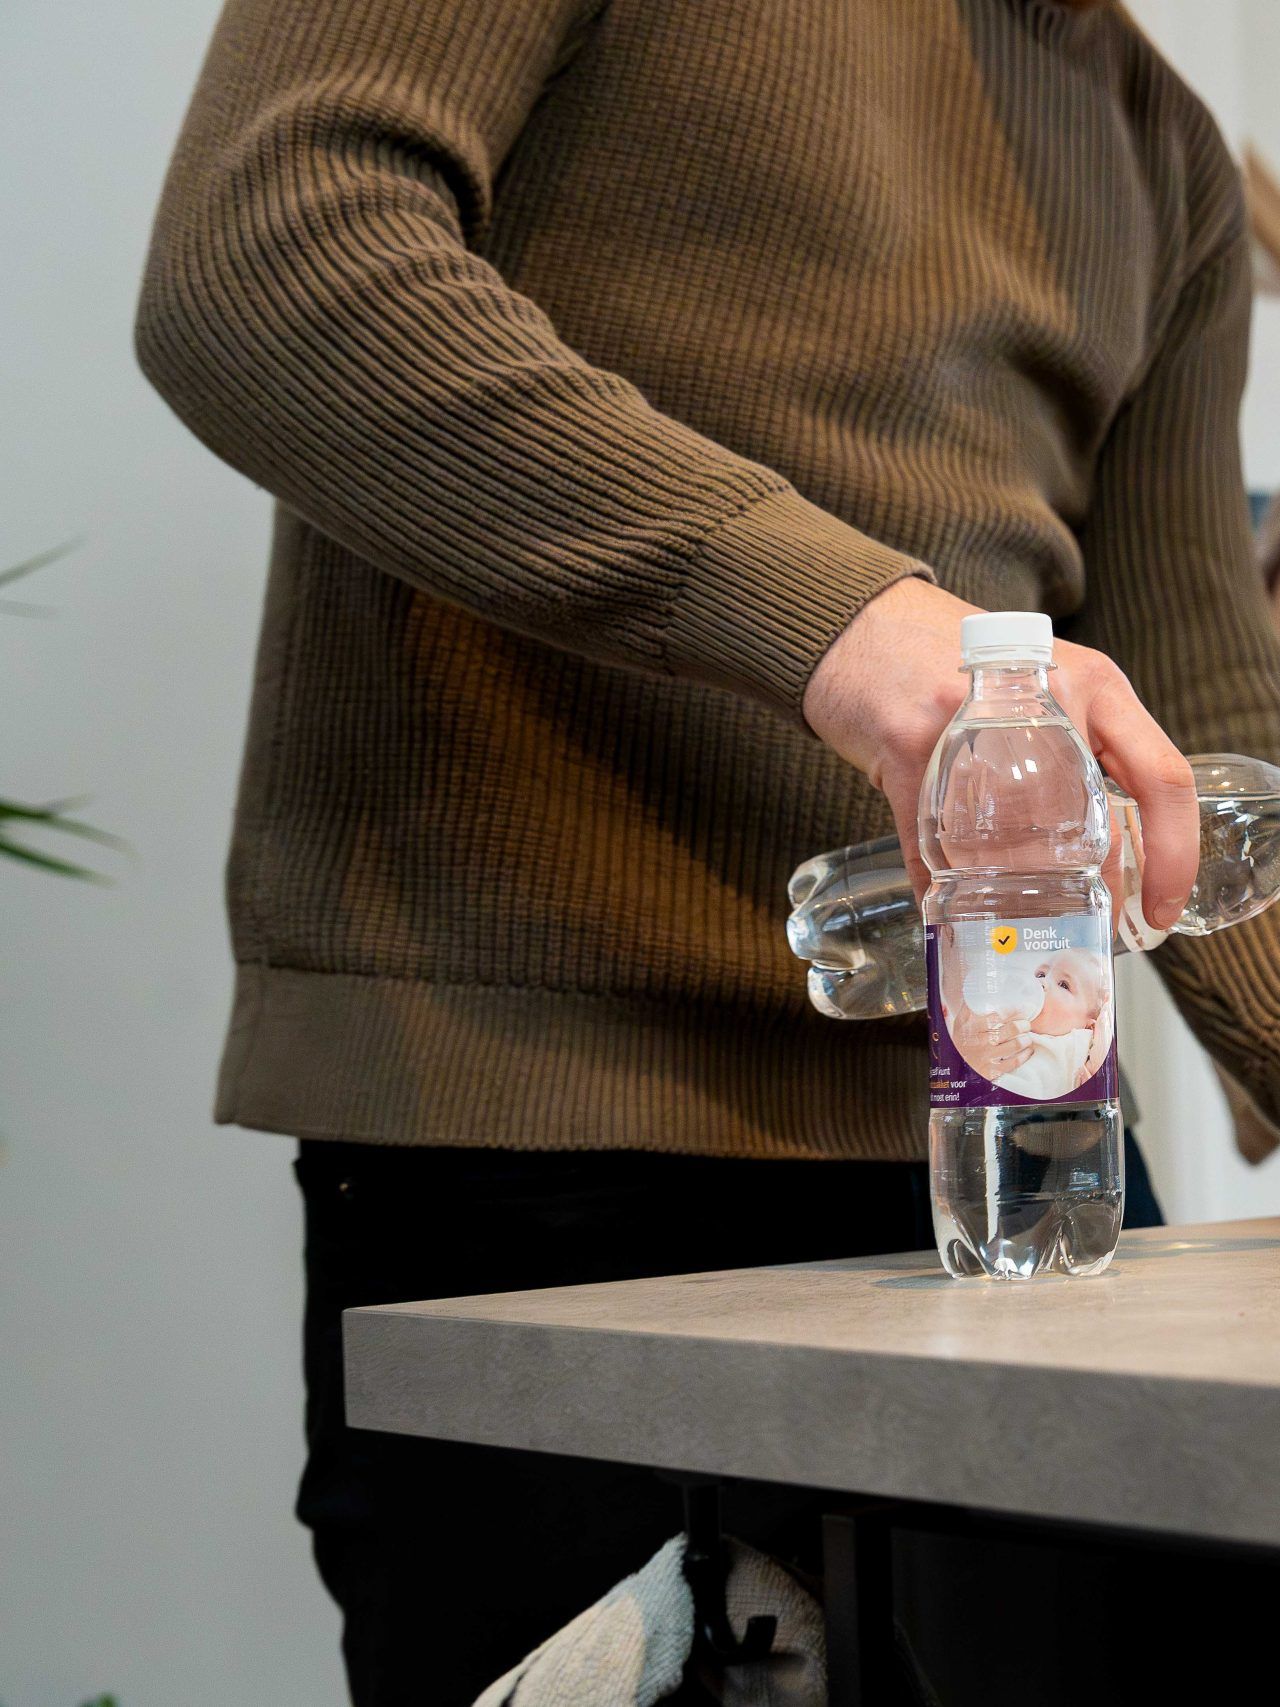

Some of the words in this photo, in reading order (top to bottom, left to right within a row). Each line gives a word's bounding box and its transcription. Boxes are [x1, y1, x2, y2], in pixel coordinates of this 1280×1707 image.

[1023, 926, 1057, 940] Denk
[1024, 937, 1071, 951] vooruit
[950, 1080, 967, 1089] voor
